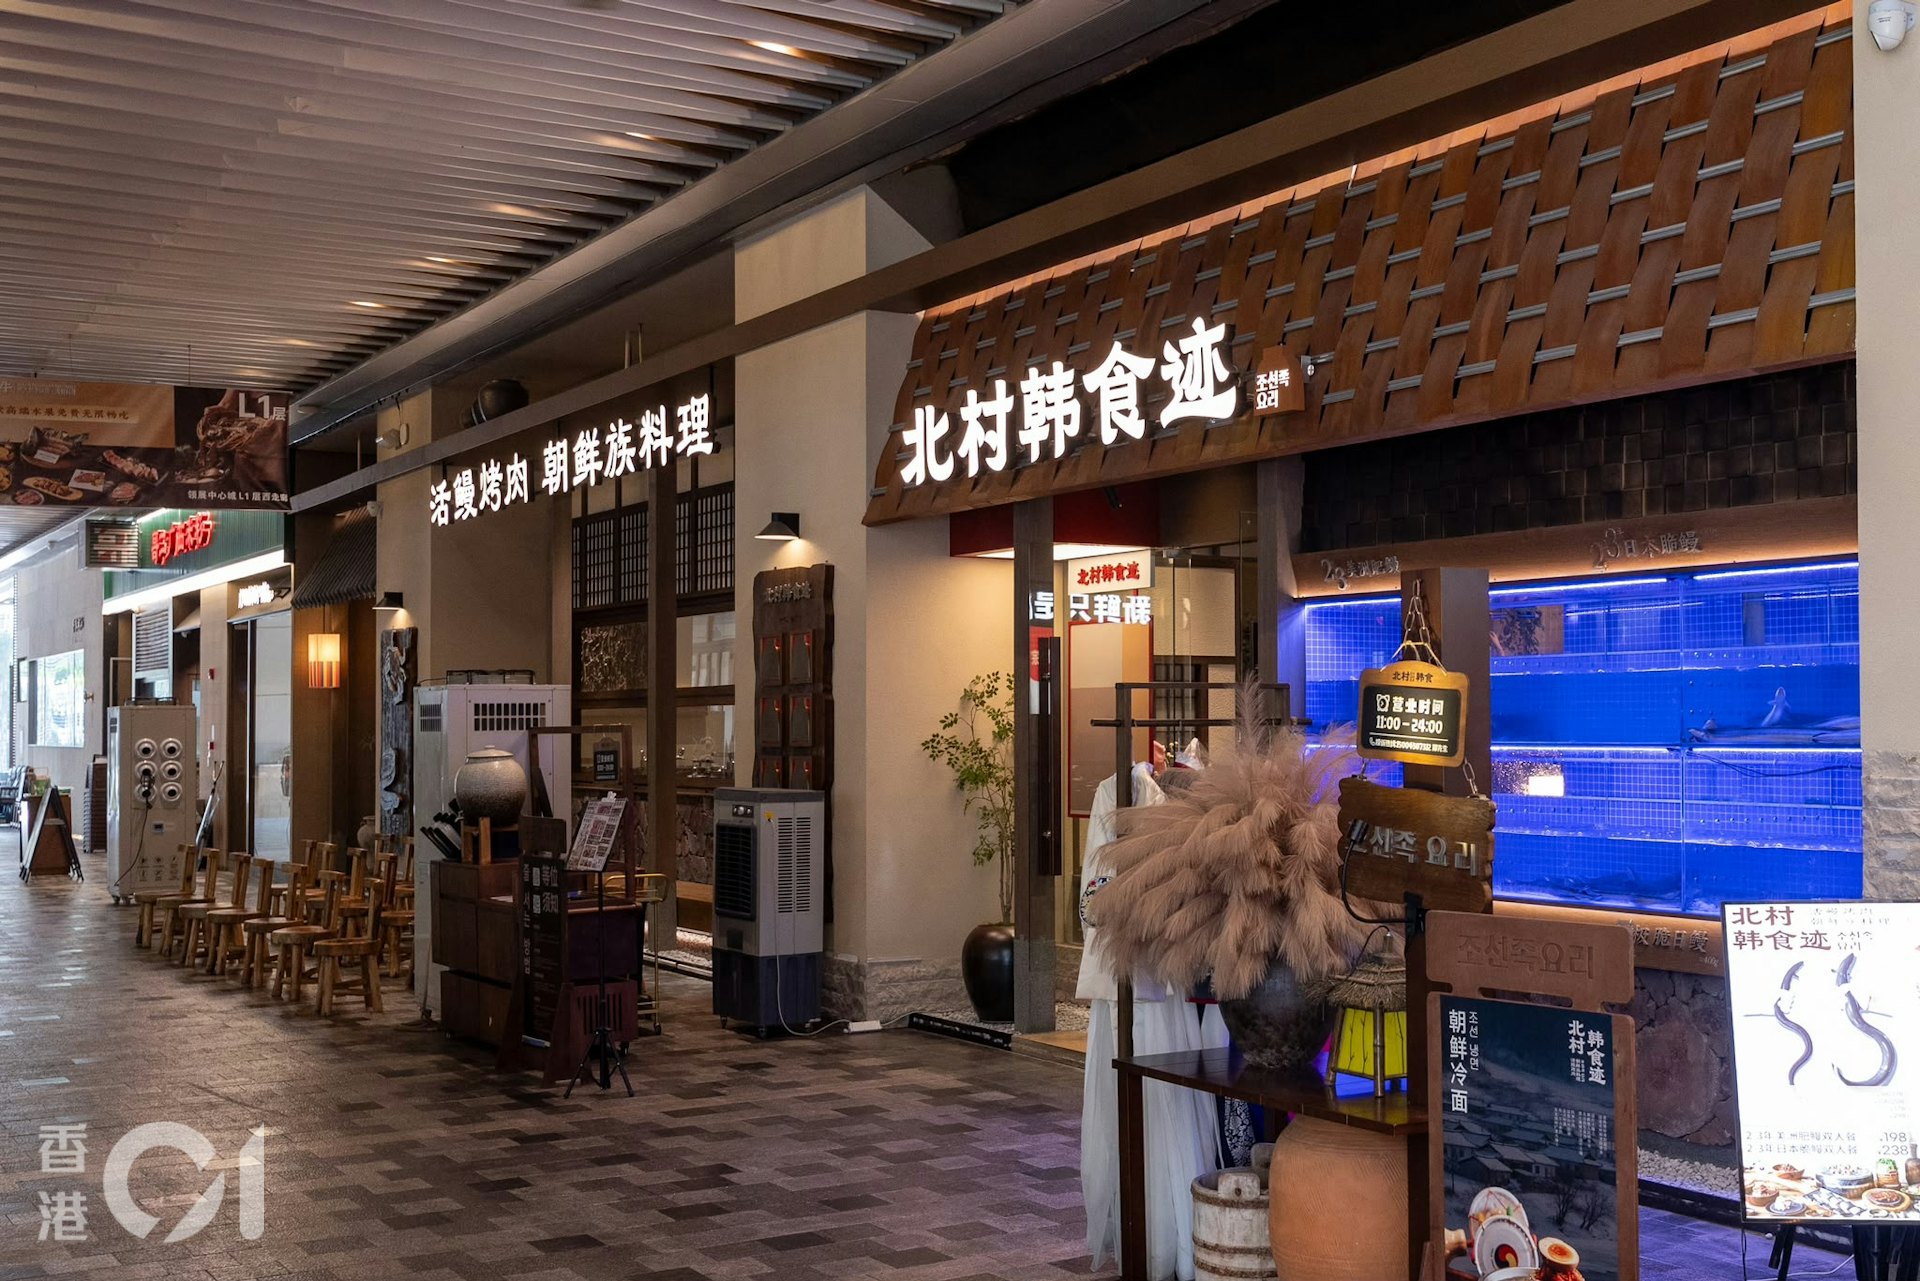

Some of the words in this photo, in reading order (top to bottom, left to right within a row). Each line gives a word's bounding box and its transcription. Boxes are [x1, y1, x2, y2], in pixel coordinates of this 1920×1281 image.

[1255, 368, 1290, 392] 조선족
[900, 316, 1237, 486] 北村韩食迹
[1255, 389, 1279, 410] 요리
[429, 452, 529, 527] 活鳗烤肉
[541, 393, 713, 496] 朝鲜族料理
[1392, 695, 1444, 716] 营业时间
[1345, 820, 1418, 864] 선족
[1424, 835, 1480, 877] 요리
[1731, 906, 1795, 926] 北村
[1733, 929, 1832, 951] 韩食迹
[1468, 1011, 1479, 1039] 조선
[1568, 1020, 1586, 1055] 北村
[1449, 1009, 1469, 1114] 朝鲜冷面
[1469, 1043, 1480, 1071] 냉면
[1587, 1029, 1607, 1086] 韩食迹
